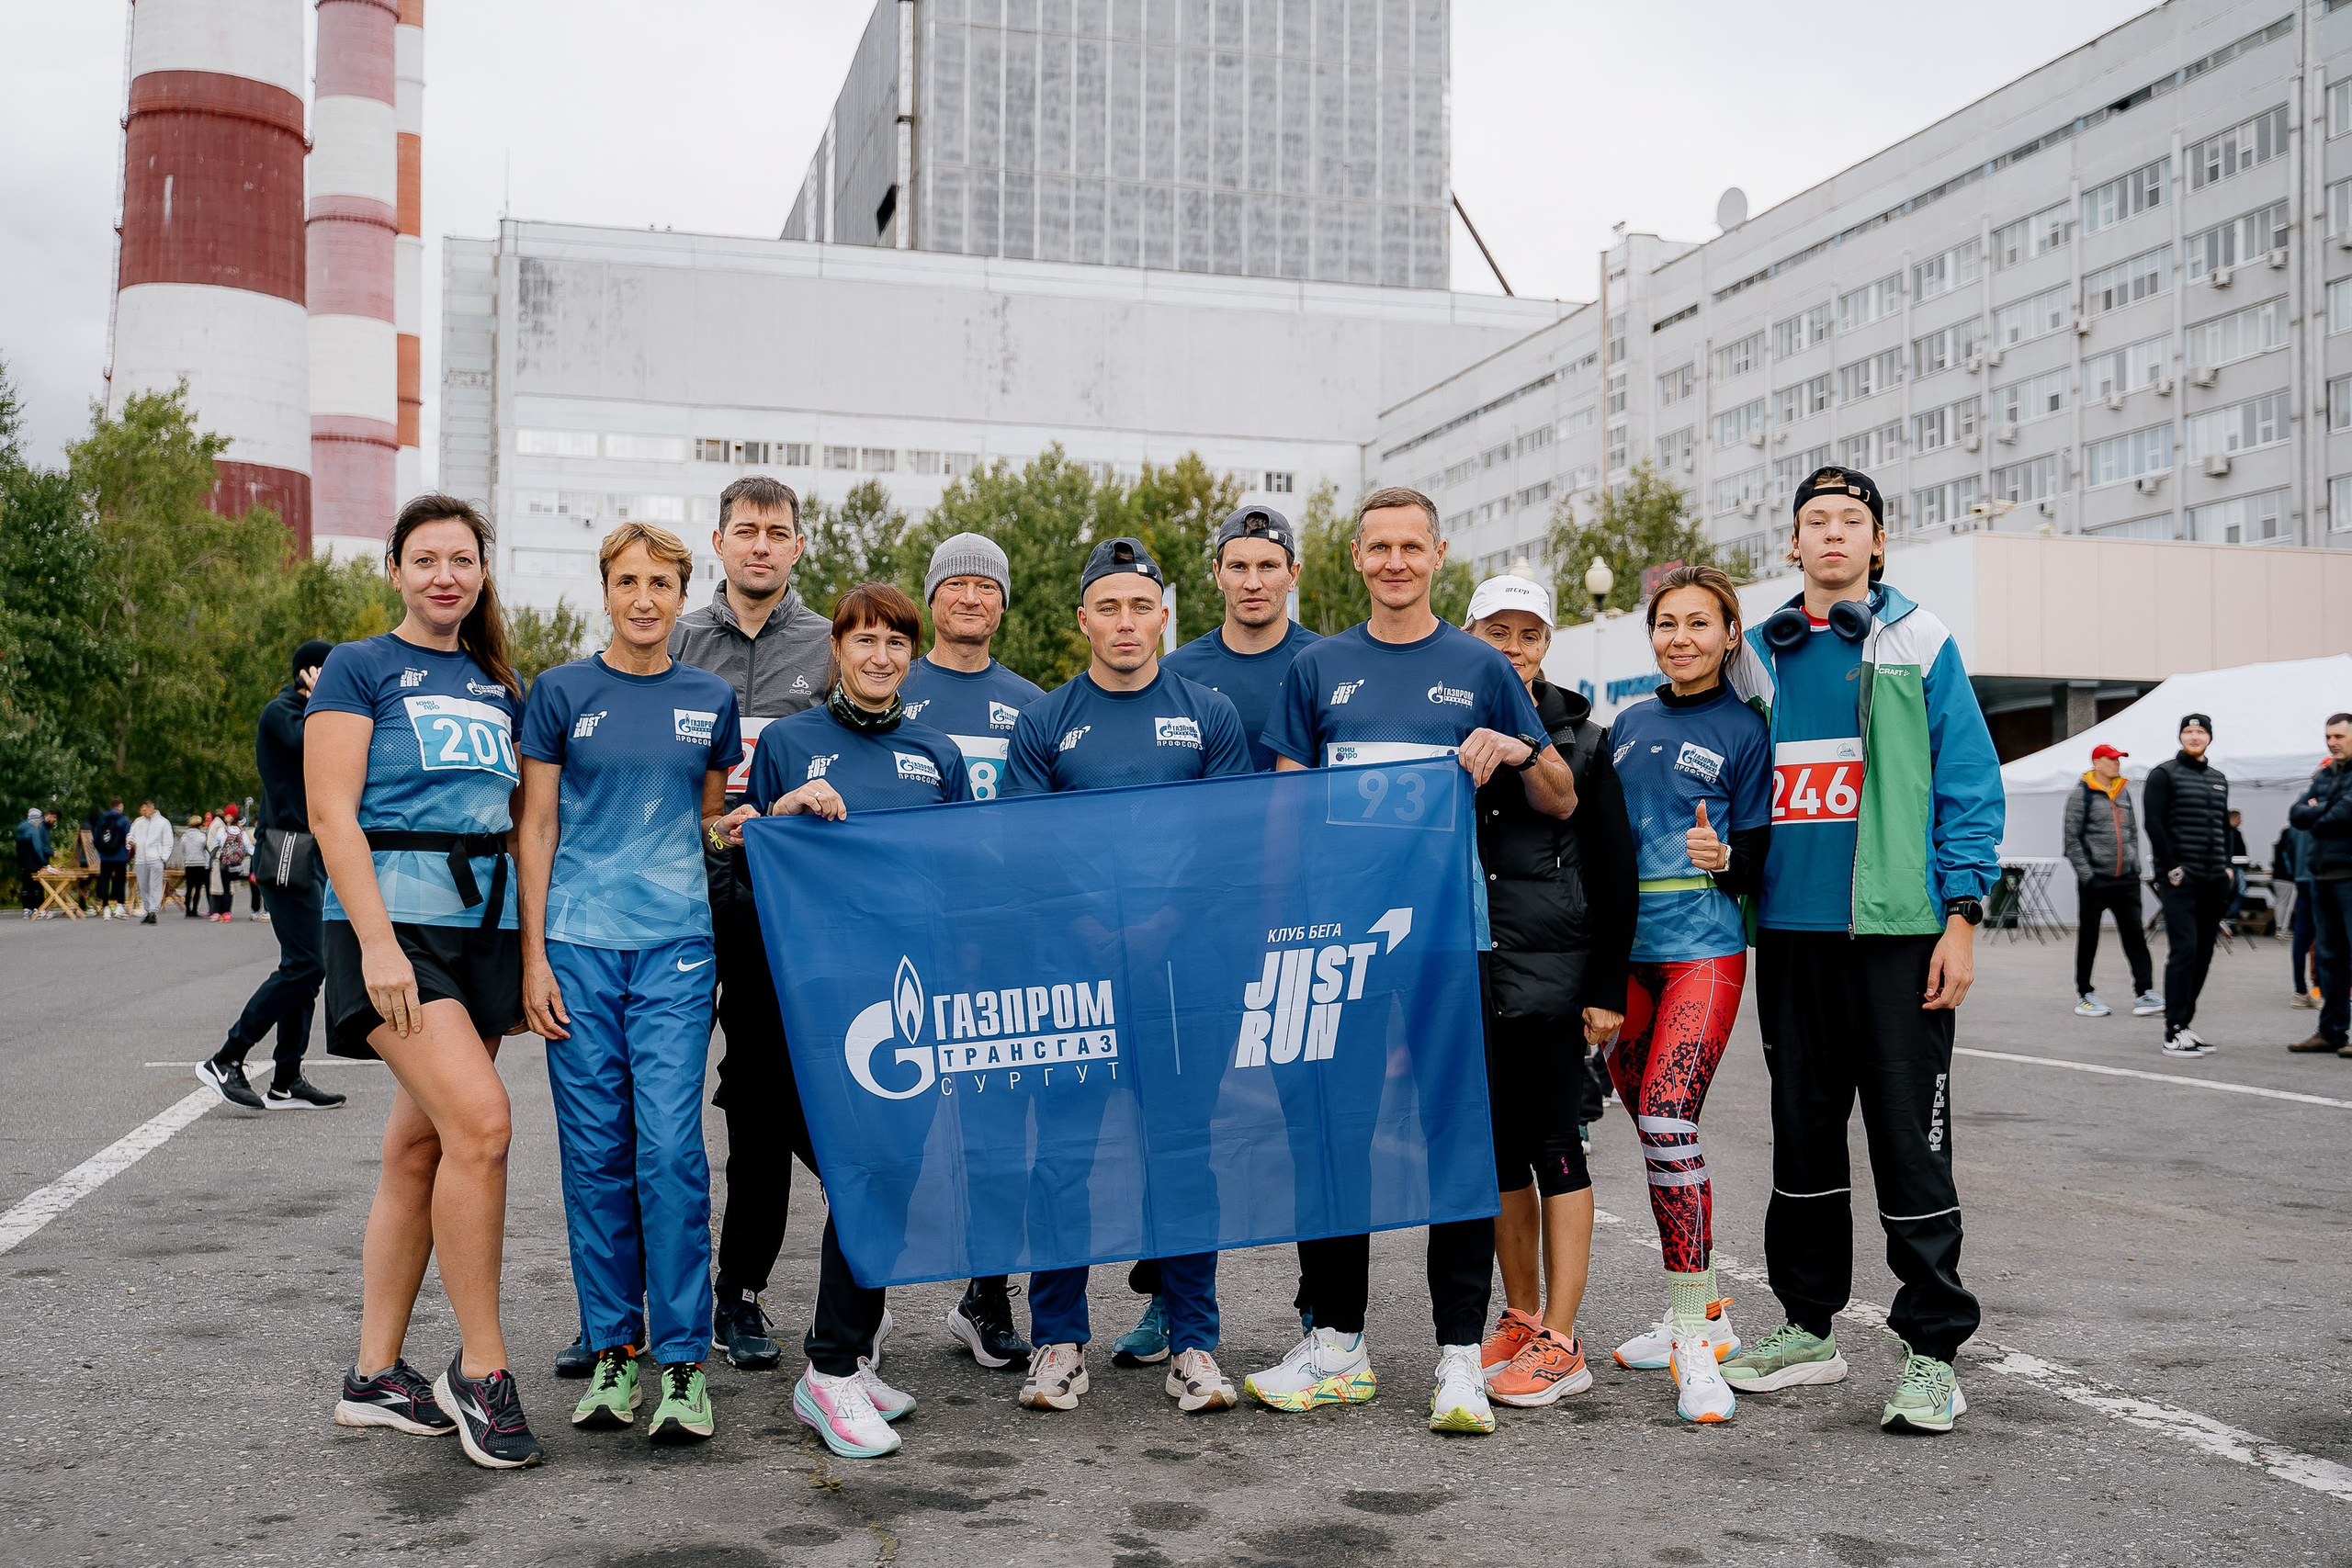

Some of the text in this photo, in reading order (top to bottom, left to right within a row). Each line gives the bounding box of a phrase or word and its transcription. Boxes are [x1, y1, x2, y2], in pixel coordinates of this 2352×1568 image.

[1878, 667, 1905, 677] CRAFT
[1333, 684, 1358, 695] JUST
[1443, 687, 1474, 701] ГАЗПРОМ
[575, 716, 601, 728] JUST
[433, 717, 518, 774] 200
[1157, 740, 1204, 750] ПРОФСОЮЗ
[808, 757, 832, 771] JUST
[1358, 770, 1426, 822] 93
[1771, 766, 1858, 817] 246
[1267, 922, 1341, 943] КЛУБ БЕГА
[1244, 942, 1378, 1011] JUST
[933, 979, 1115, 1041] ГАЗПРОМ
[944, 1034, 1114, 1067] ТРАНСГАЗ
[1234, 1001, 1343, 1069] RUN
[941, 1062, 1119, 1096] СУРГУТ
